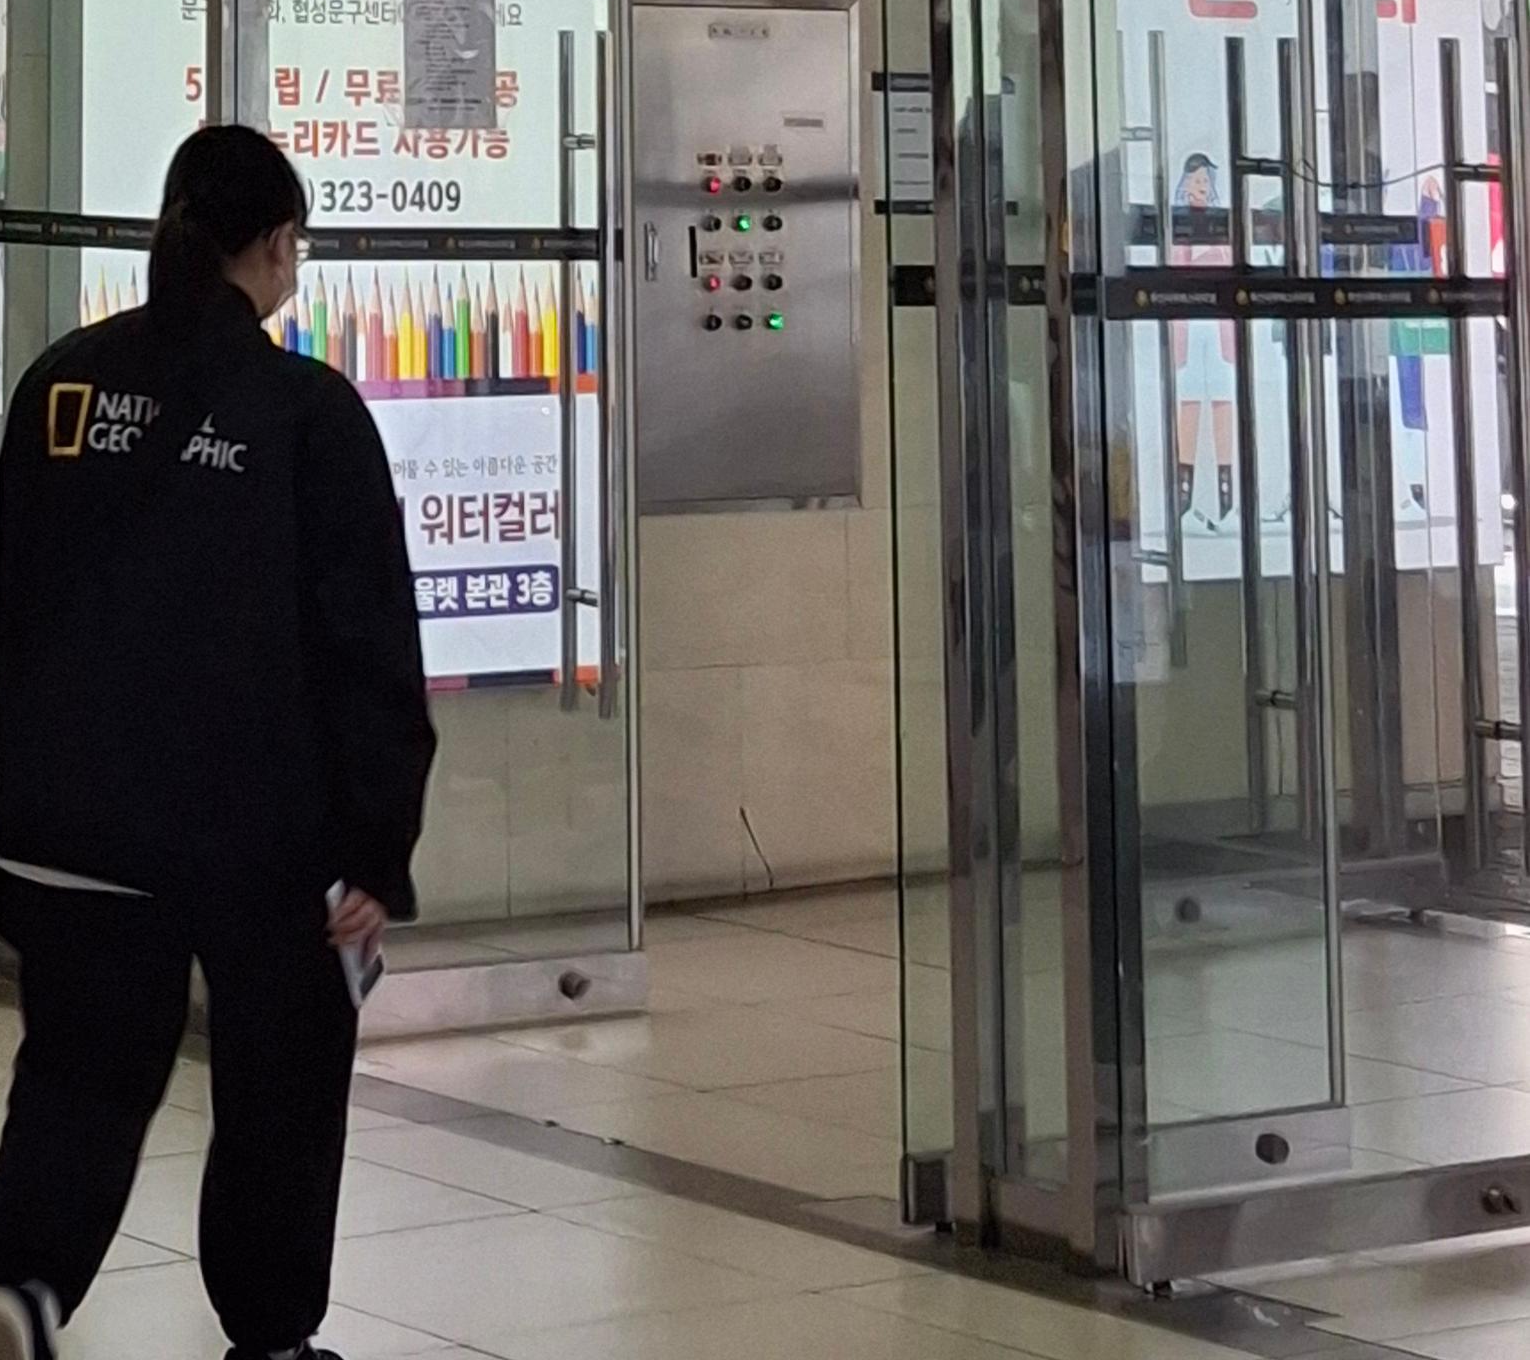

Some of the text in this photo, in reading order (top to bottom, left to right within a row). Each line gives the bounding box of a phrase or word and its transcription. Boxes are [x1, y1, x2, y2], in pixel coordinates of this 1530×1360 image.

[292, 0, 404, 27] 협성문구센터
[307, 177, 461, 213] )323-0409
[420, 490, 560, 545] 워터컬러
[414, 570, 553, 612] 울렛 본관 3층
